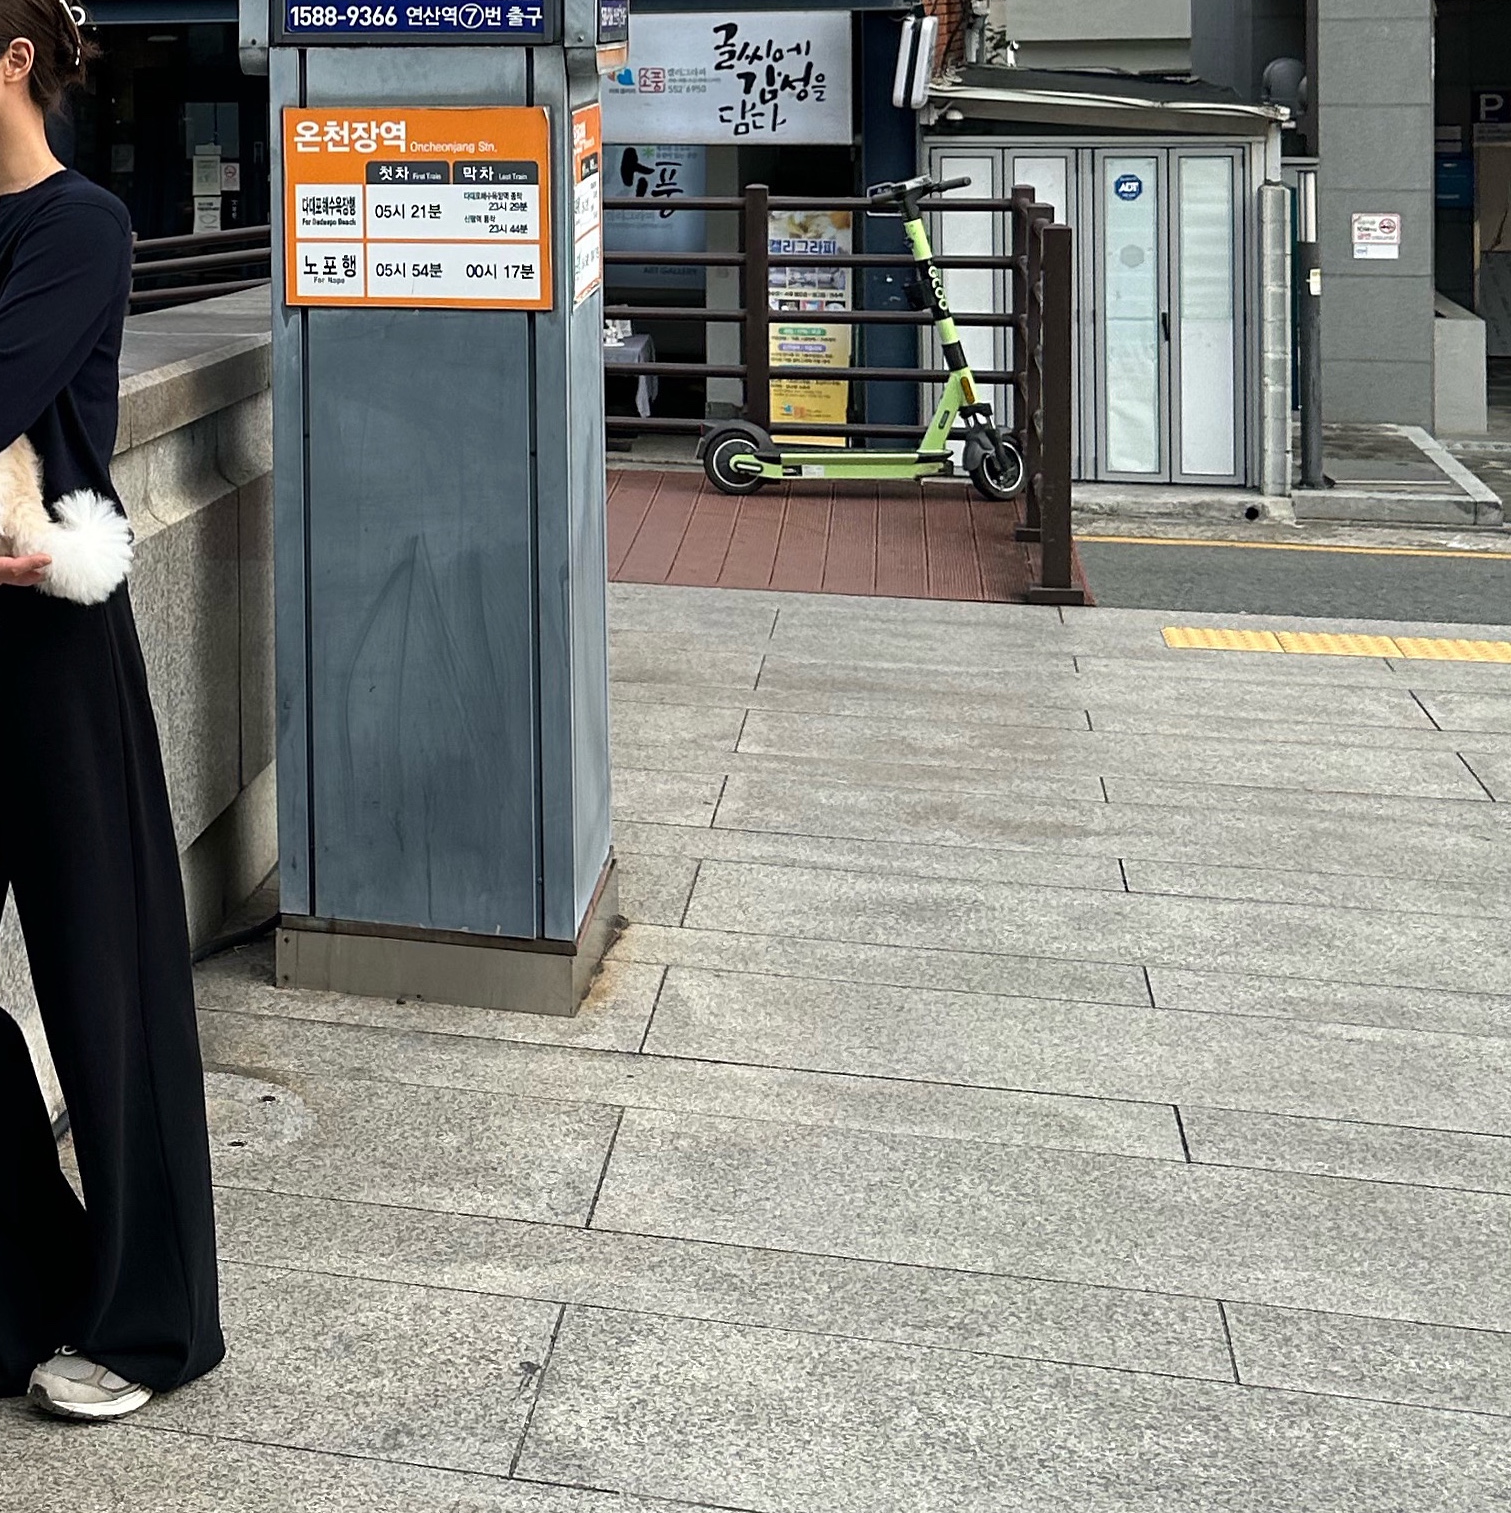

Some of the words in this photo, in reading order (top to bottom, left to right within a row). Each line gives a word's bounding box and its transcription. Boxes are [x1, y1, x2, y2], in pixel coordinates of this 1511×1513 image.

[290, 5, 398, 27] 1588-9366
[506, 5, 543, 26] 출구
[713, 22, 811, 71] 글씨에
[737, 61, 827, 105] 감성을
[718, 99, 787, 136] 담다
[1479, 93, 1504, 121] P
[293, 120, 407, 154] 온천장역
[410, 141, 475, 155] Oncheonjang
[478, 141, 498, 154] Stn.
[375, 203, 405, 219] 05시
[411, 203, 442, 219] 21분
[375, 262, 406, 278] 05시
[412, 262, 443, 278] 54분
[466, 263, 497, 280] 00시
[503, 263, 535, 280] 17분
